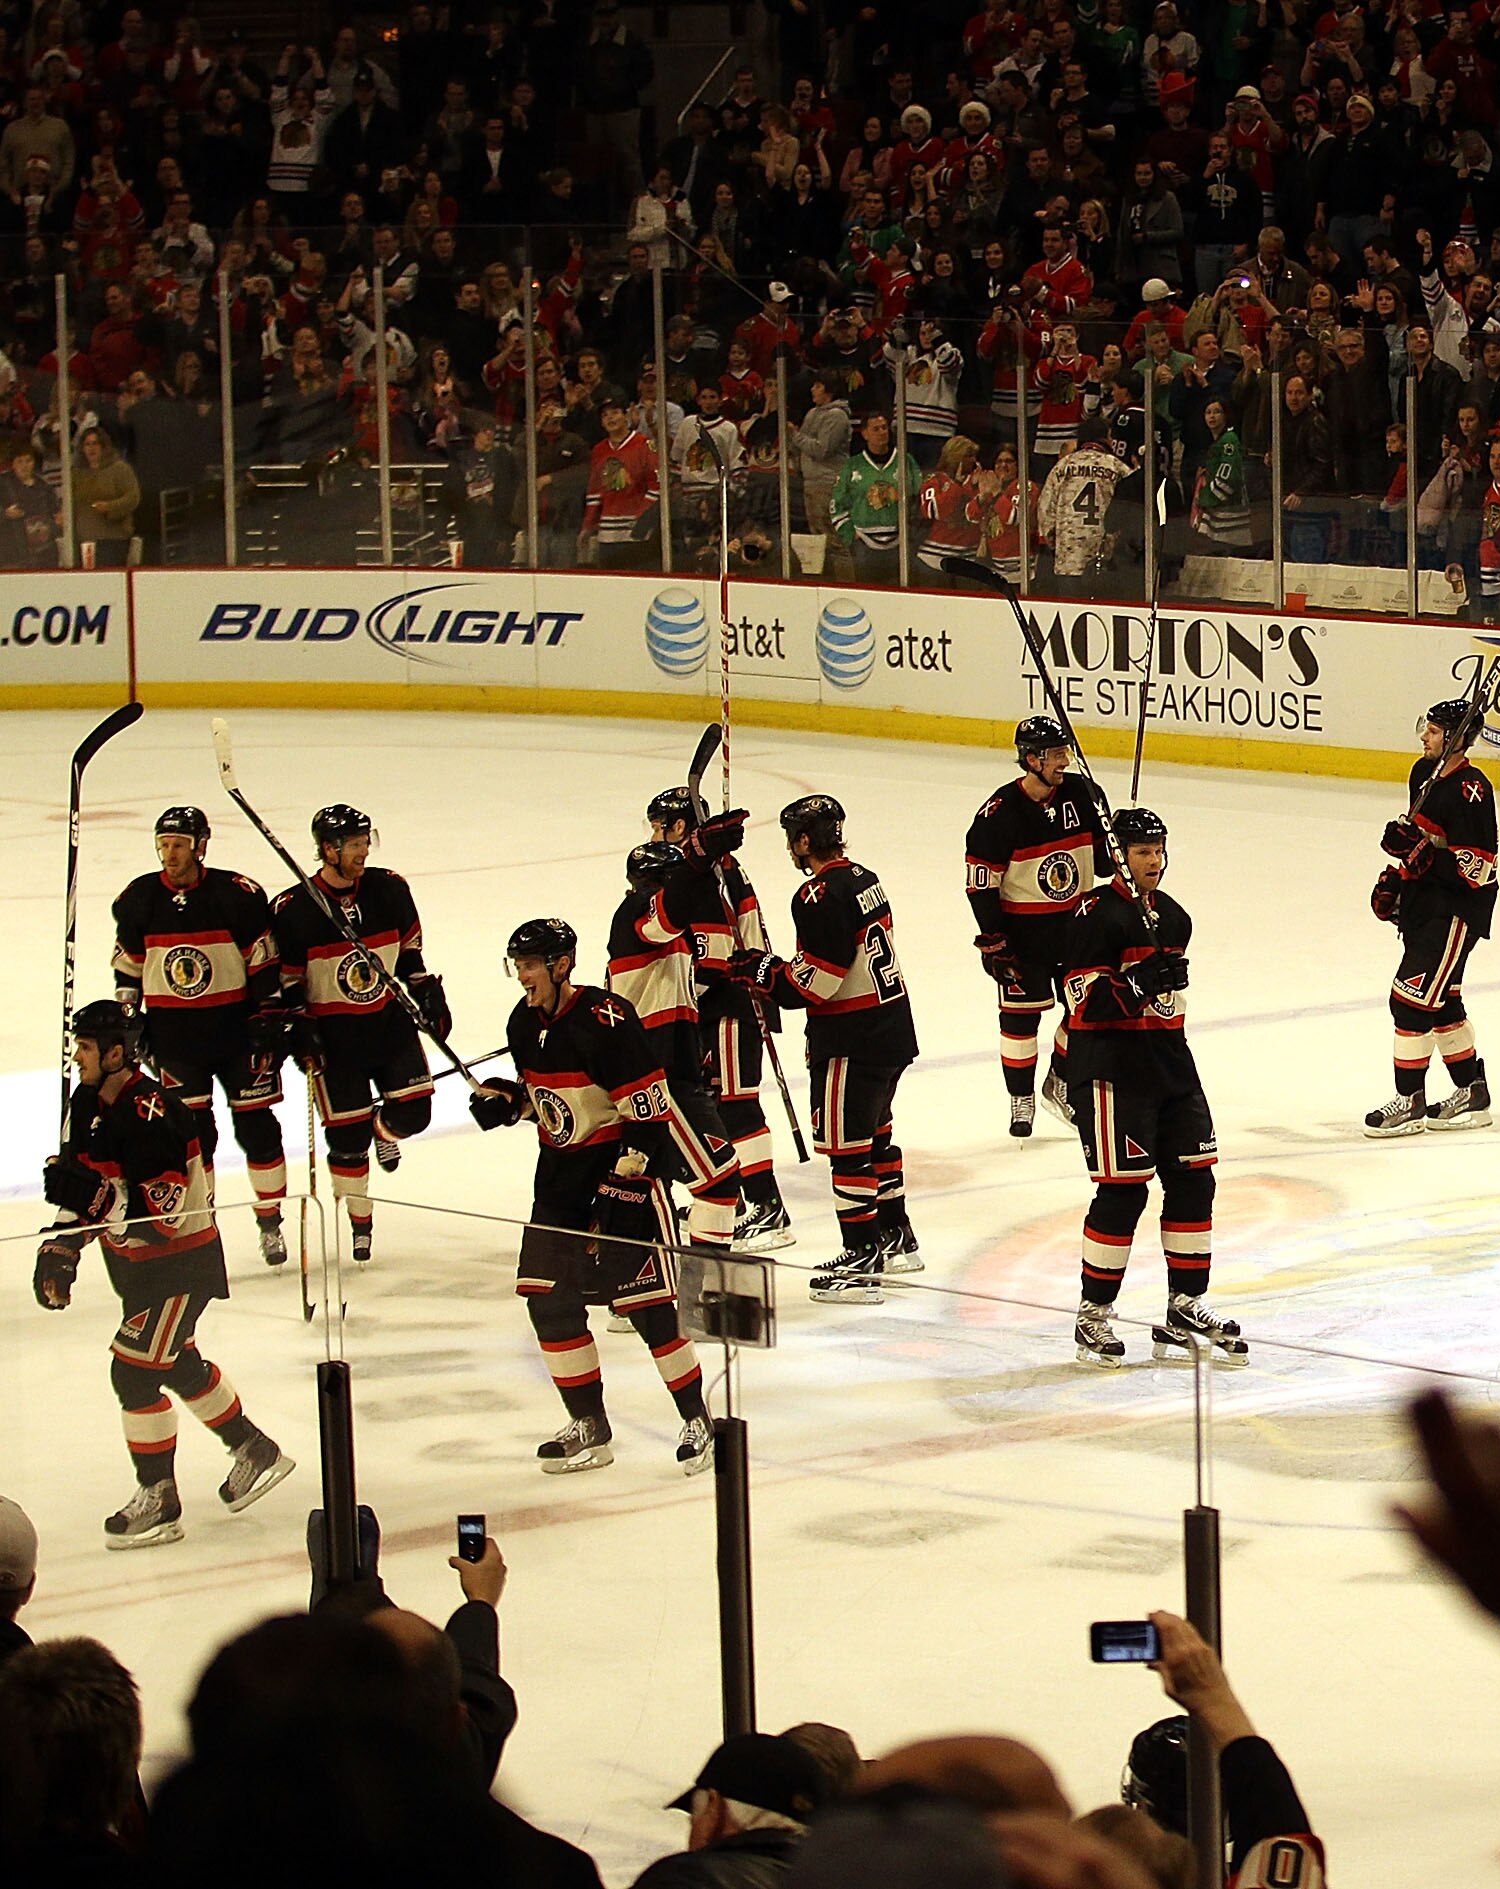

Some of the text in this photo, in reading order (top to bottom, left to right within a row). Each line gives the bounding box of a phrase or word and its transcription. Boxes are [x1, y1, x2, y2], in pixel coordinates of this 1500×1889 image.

[1071, 481, 1100, 526] 4
[199, 603, 585, 646] BUD LIGHT
[726, 614, 785, 661] at&t
[886, 629, 953, 674] at&t
[1021, 610, 1322, 688] MORTON'S
[1021, 674, 1324, 732] THE STEAKHOUSE
[1063, 801, 1080, 829] A
[1067, 974, 1086, 1005] 5
[629, 1081, 671, 1121] 82
[617, 1277, 658, 1292] EASTON
